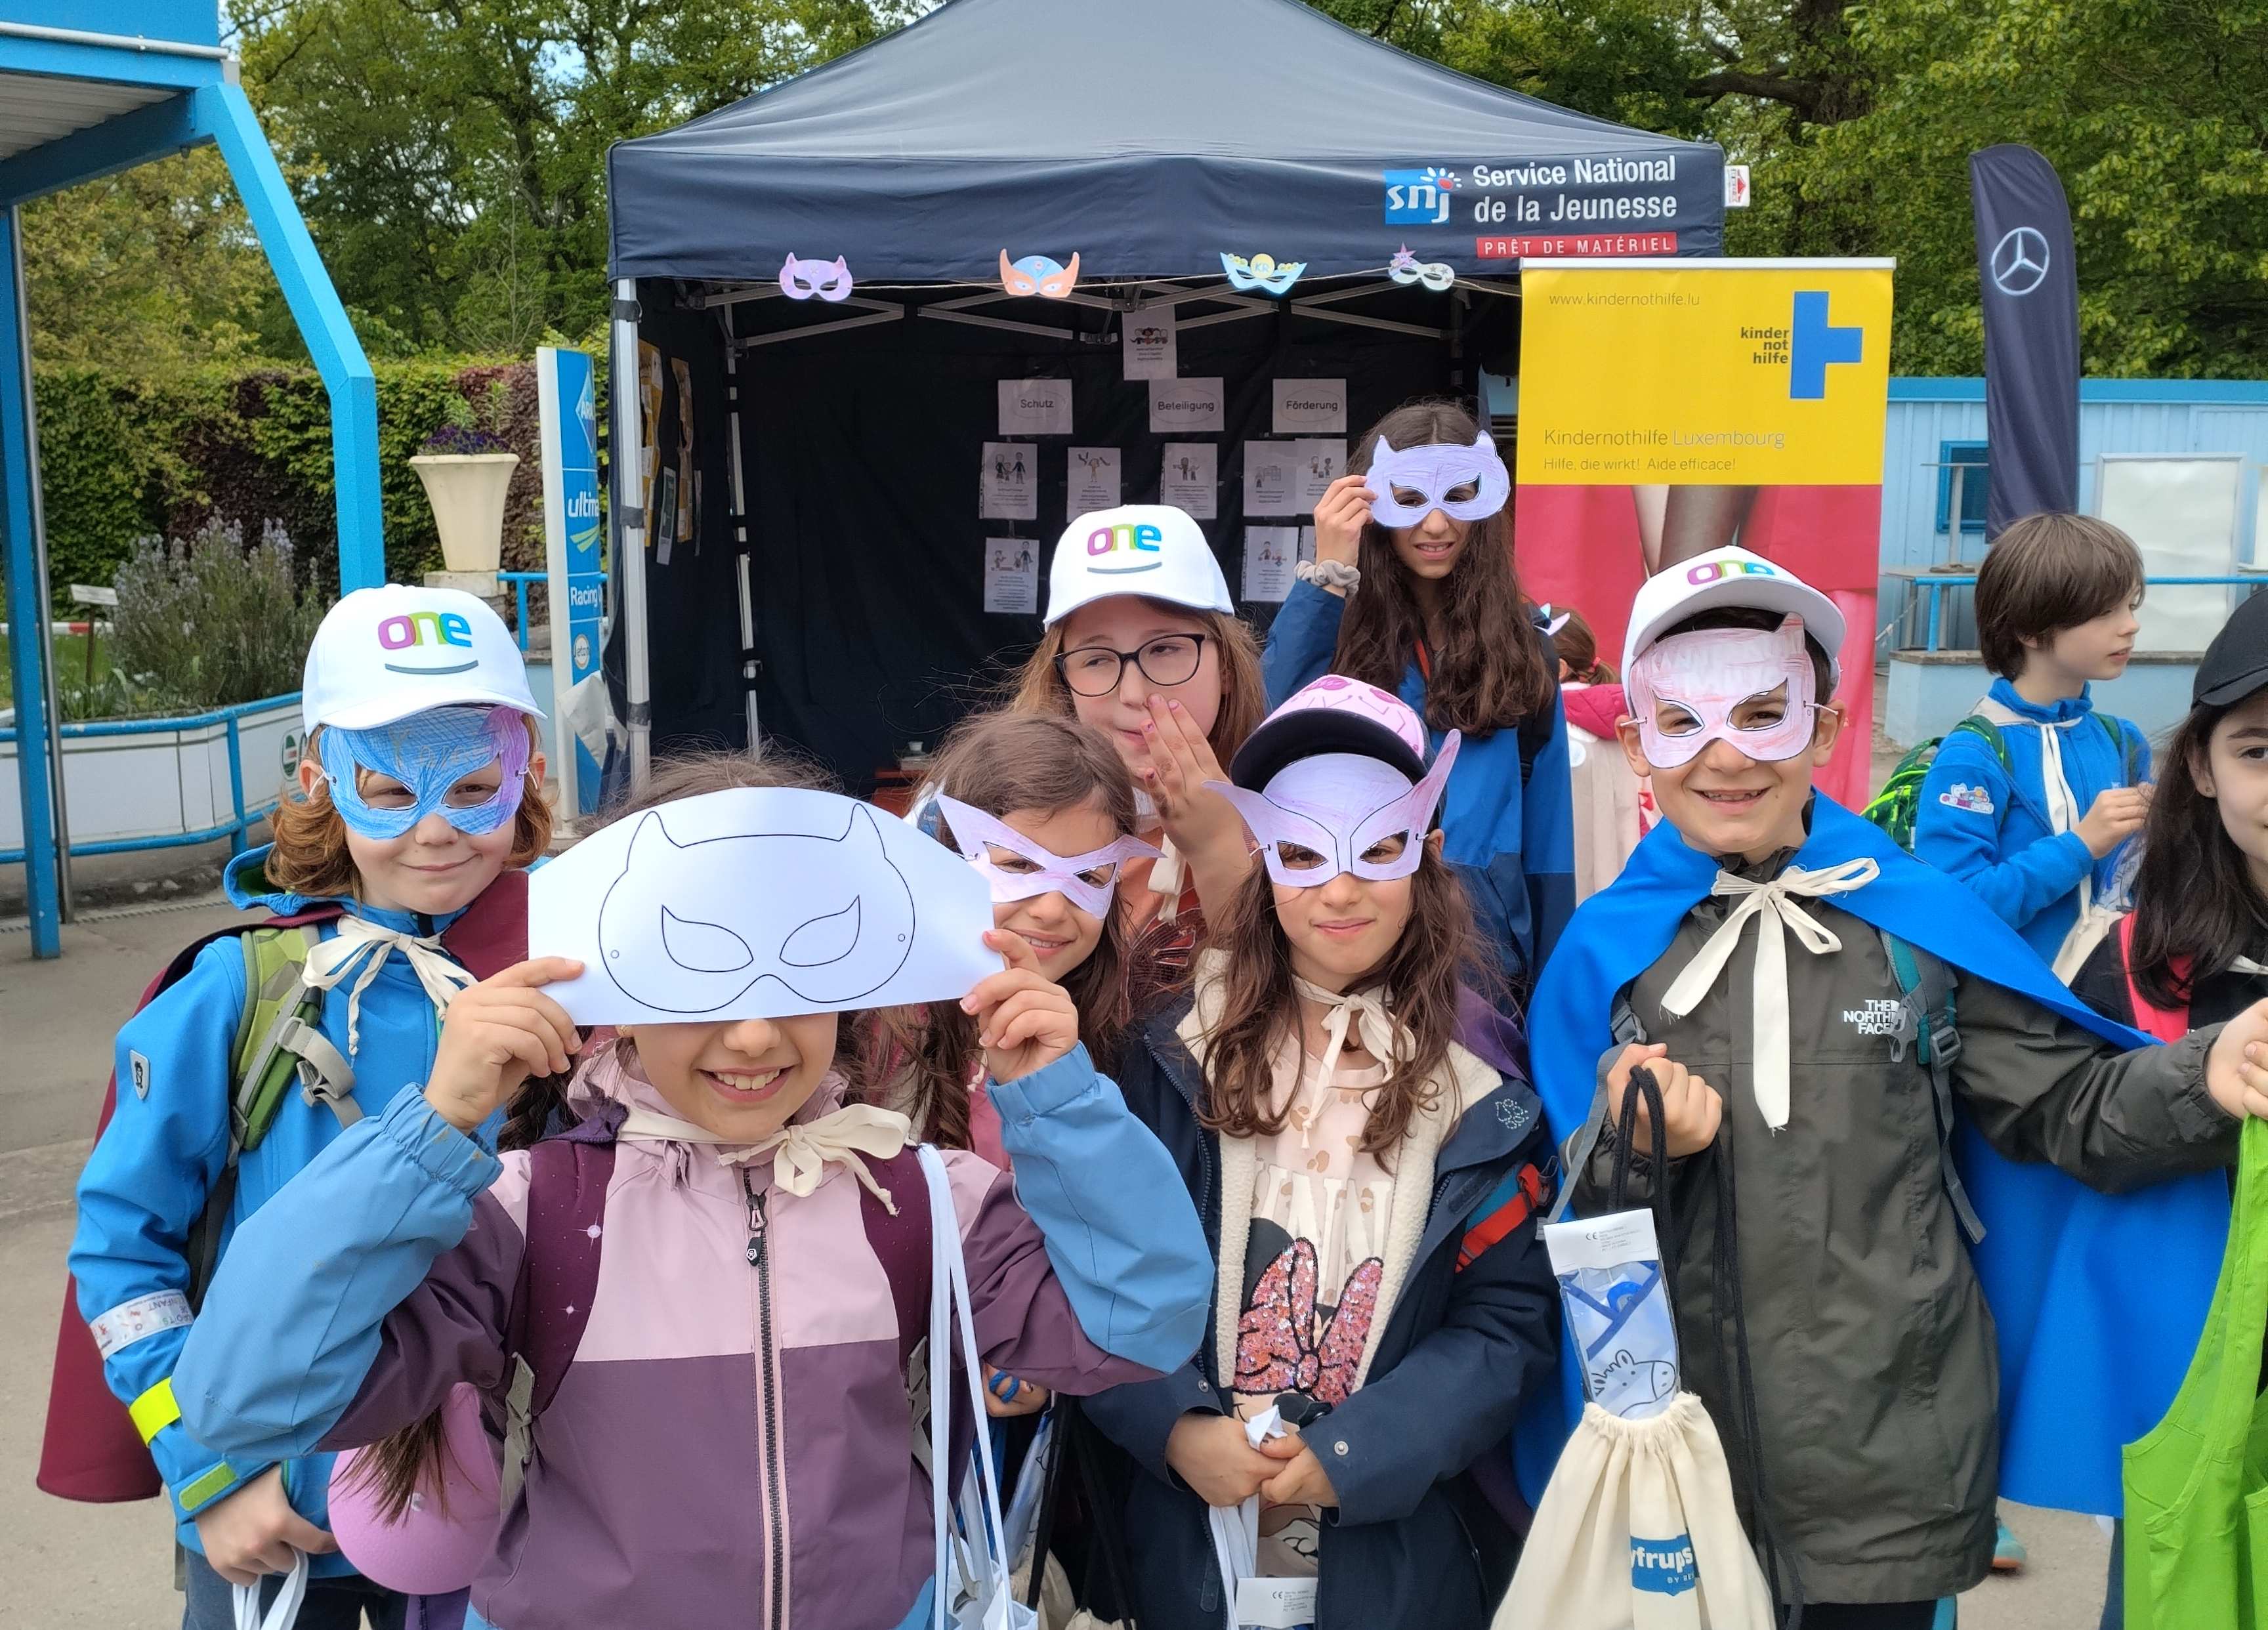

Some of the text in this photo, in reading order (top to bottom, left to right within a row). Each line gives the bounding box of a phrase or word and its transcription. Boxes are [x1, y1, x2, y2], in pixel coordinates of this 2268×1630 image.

[1473, 155, 1675, 187] Service National
[1387, 181, 1449, 224] snj
[1474, 194, 1677, 222] de la Jeunesse
[1484, 236, 1672, 255] PRÊT DE MATÉRIEL
[1549, 293, 1700, 306] www.kindernothilfe.lu
[1740, 326, 1789, 339] kinder
[1763, 339, 1789, 350] not
[1752, 352, 1788, 364] hilfe
[1020, 398, 1055, 409] Schutz
[1158, 400, 1215, 413] Beteiligung
[1286, 399, 1338, 412] Förderung
[1544, 428, 1785, 449] Kindernothilfe Luxembourg
[1544, 457, 1736, 471] Hilfe, die wirkt! Aide efficace!
[1087, 523, 1162, 556] one
[570, 585, 598, 608] Racing
[378, 611, 472, 650] one
[1865, 999, 1891, 1011] THE
[1843, 1010, 1892, 1023] NORTH
